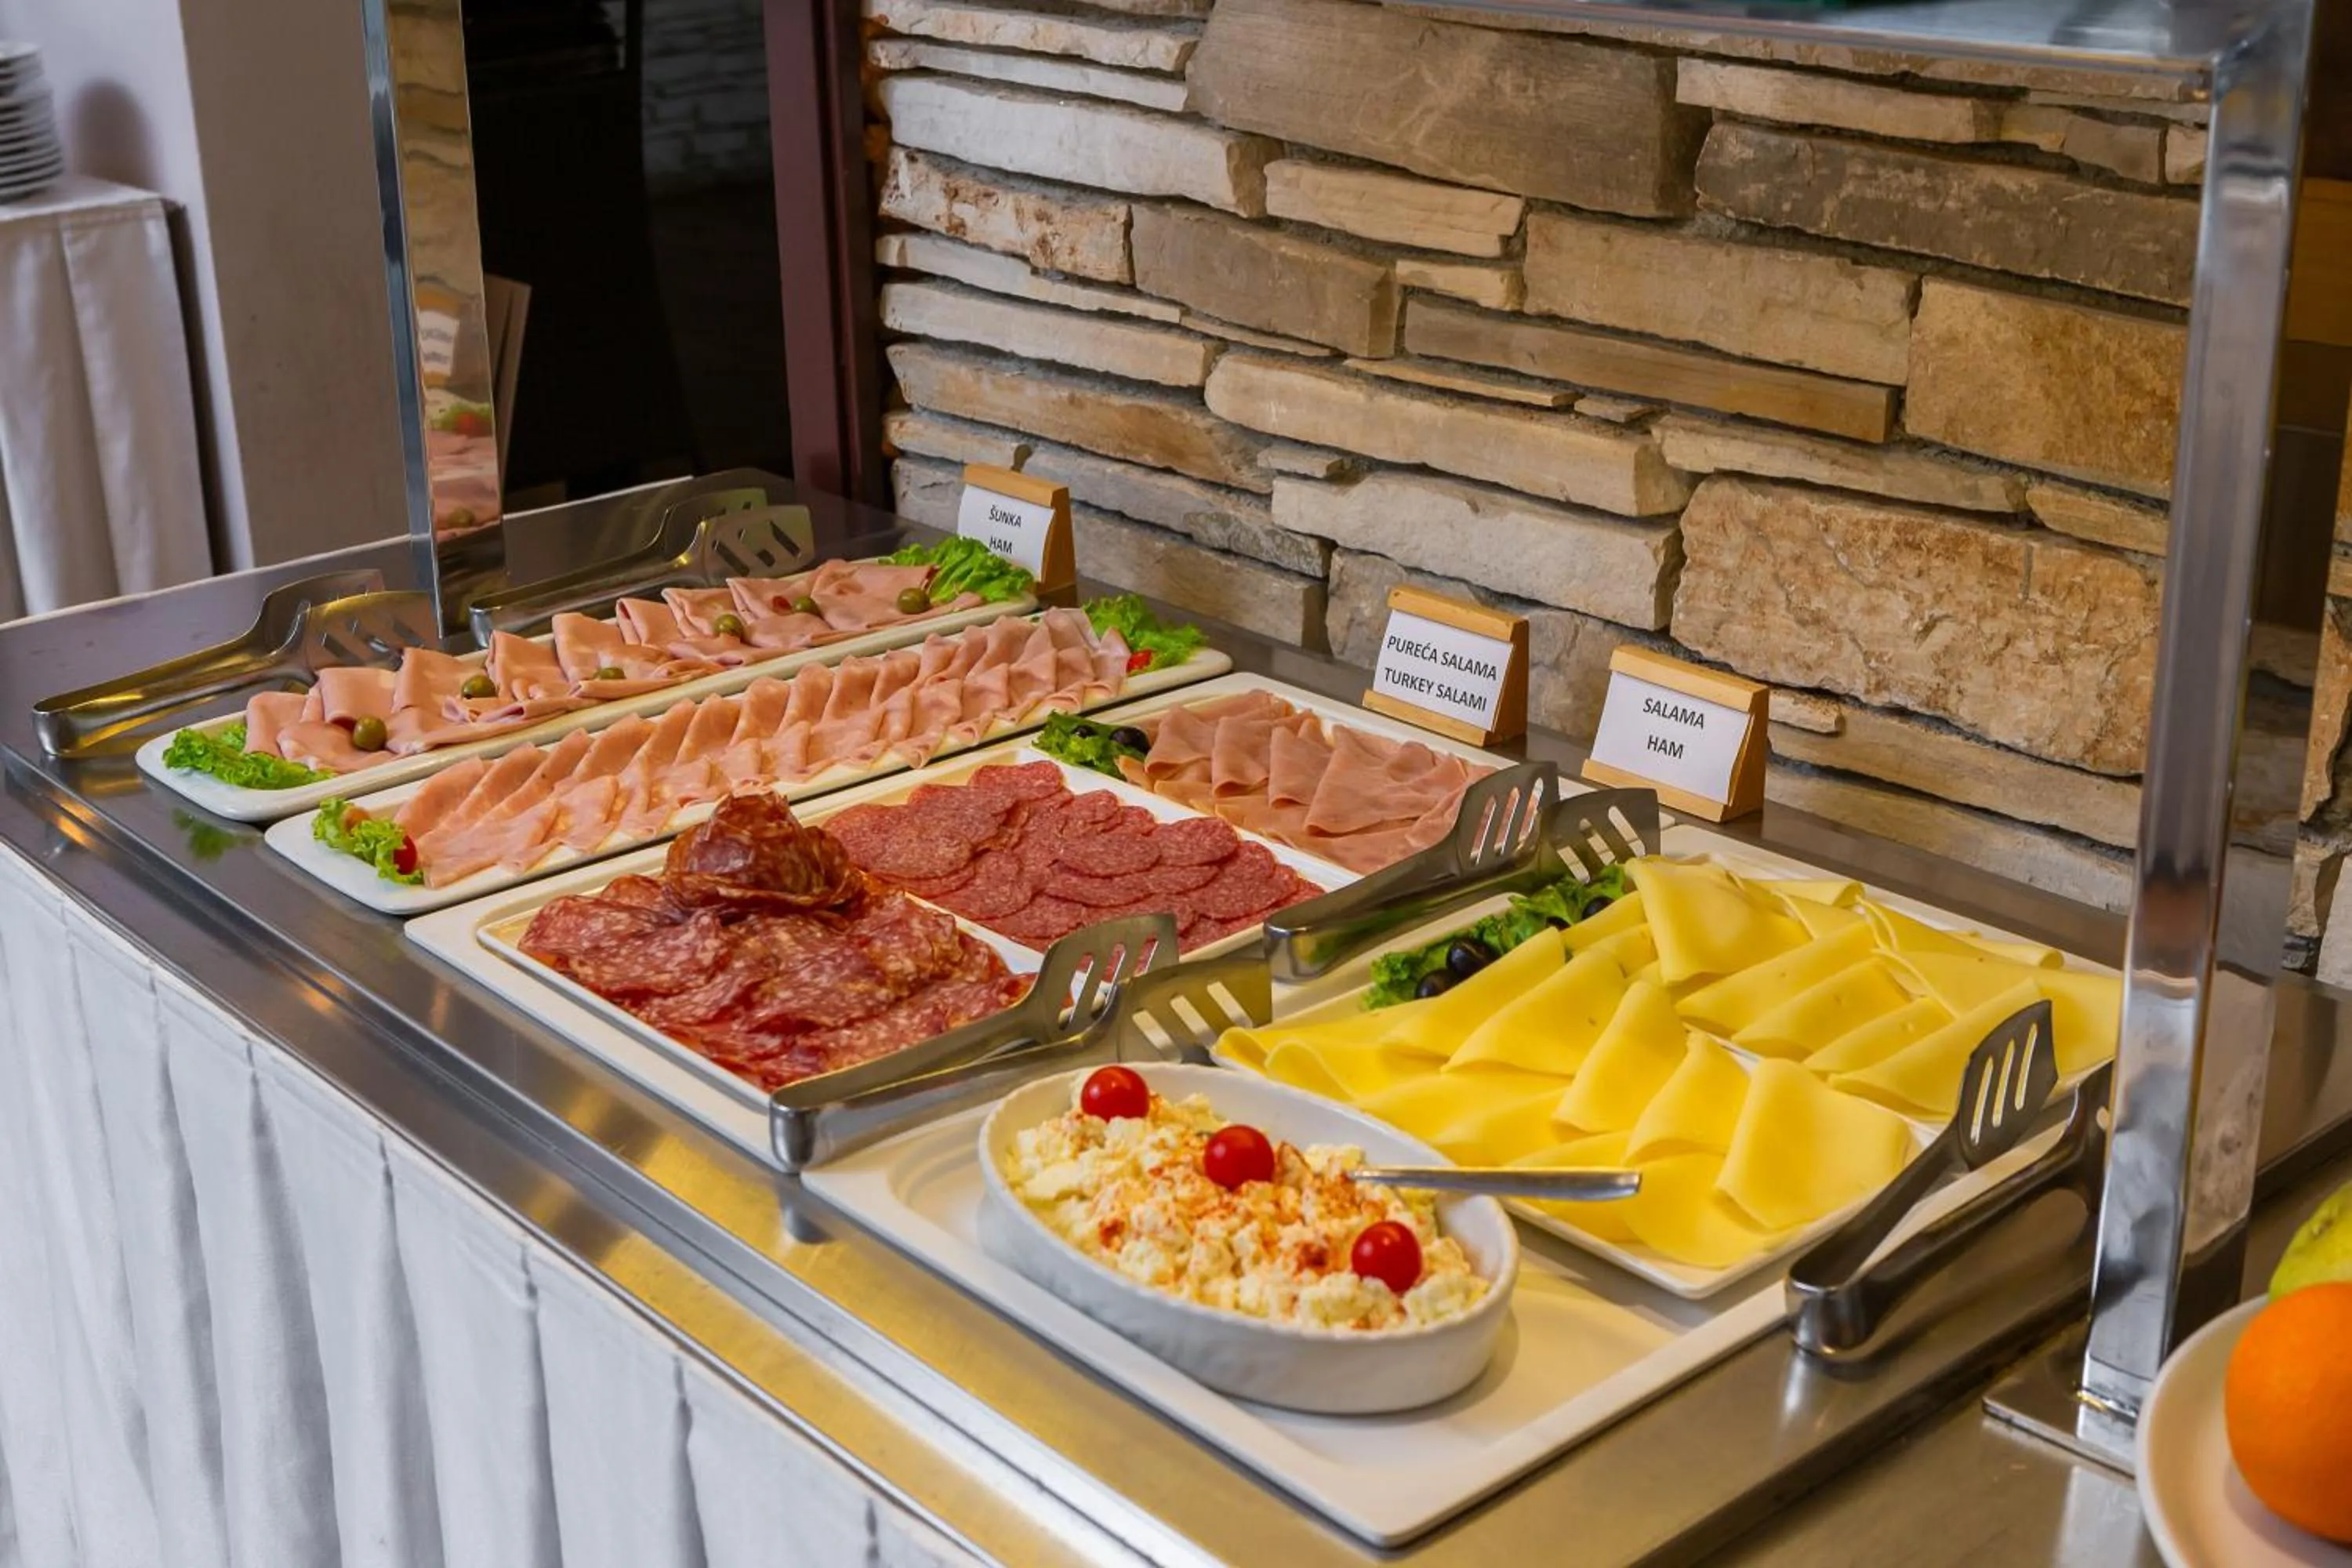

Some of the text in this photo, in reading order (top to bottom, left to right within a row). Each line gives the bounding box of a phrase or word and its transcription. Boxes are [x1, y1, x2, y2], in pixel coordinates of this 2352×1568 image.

[989, 504, 1022, 527] ŠUNKA
[989, 535, 1012, 554] HAM
[1387, 635, 1497, 681] PUREĆA SALAMA
[1385, 667, 1487, 712] TURKEY SALAMI
[1642, 698, 1704, 729] SALAMA
[1647, 735, 1684, 759] HAM
